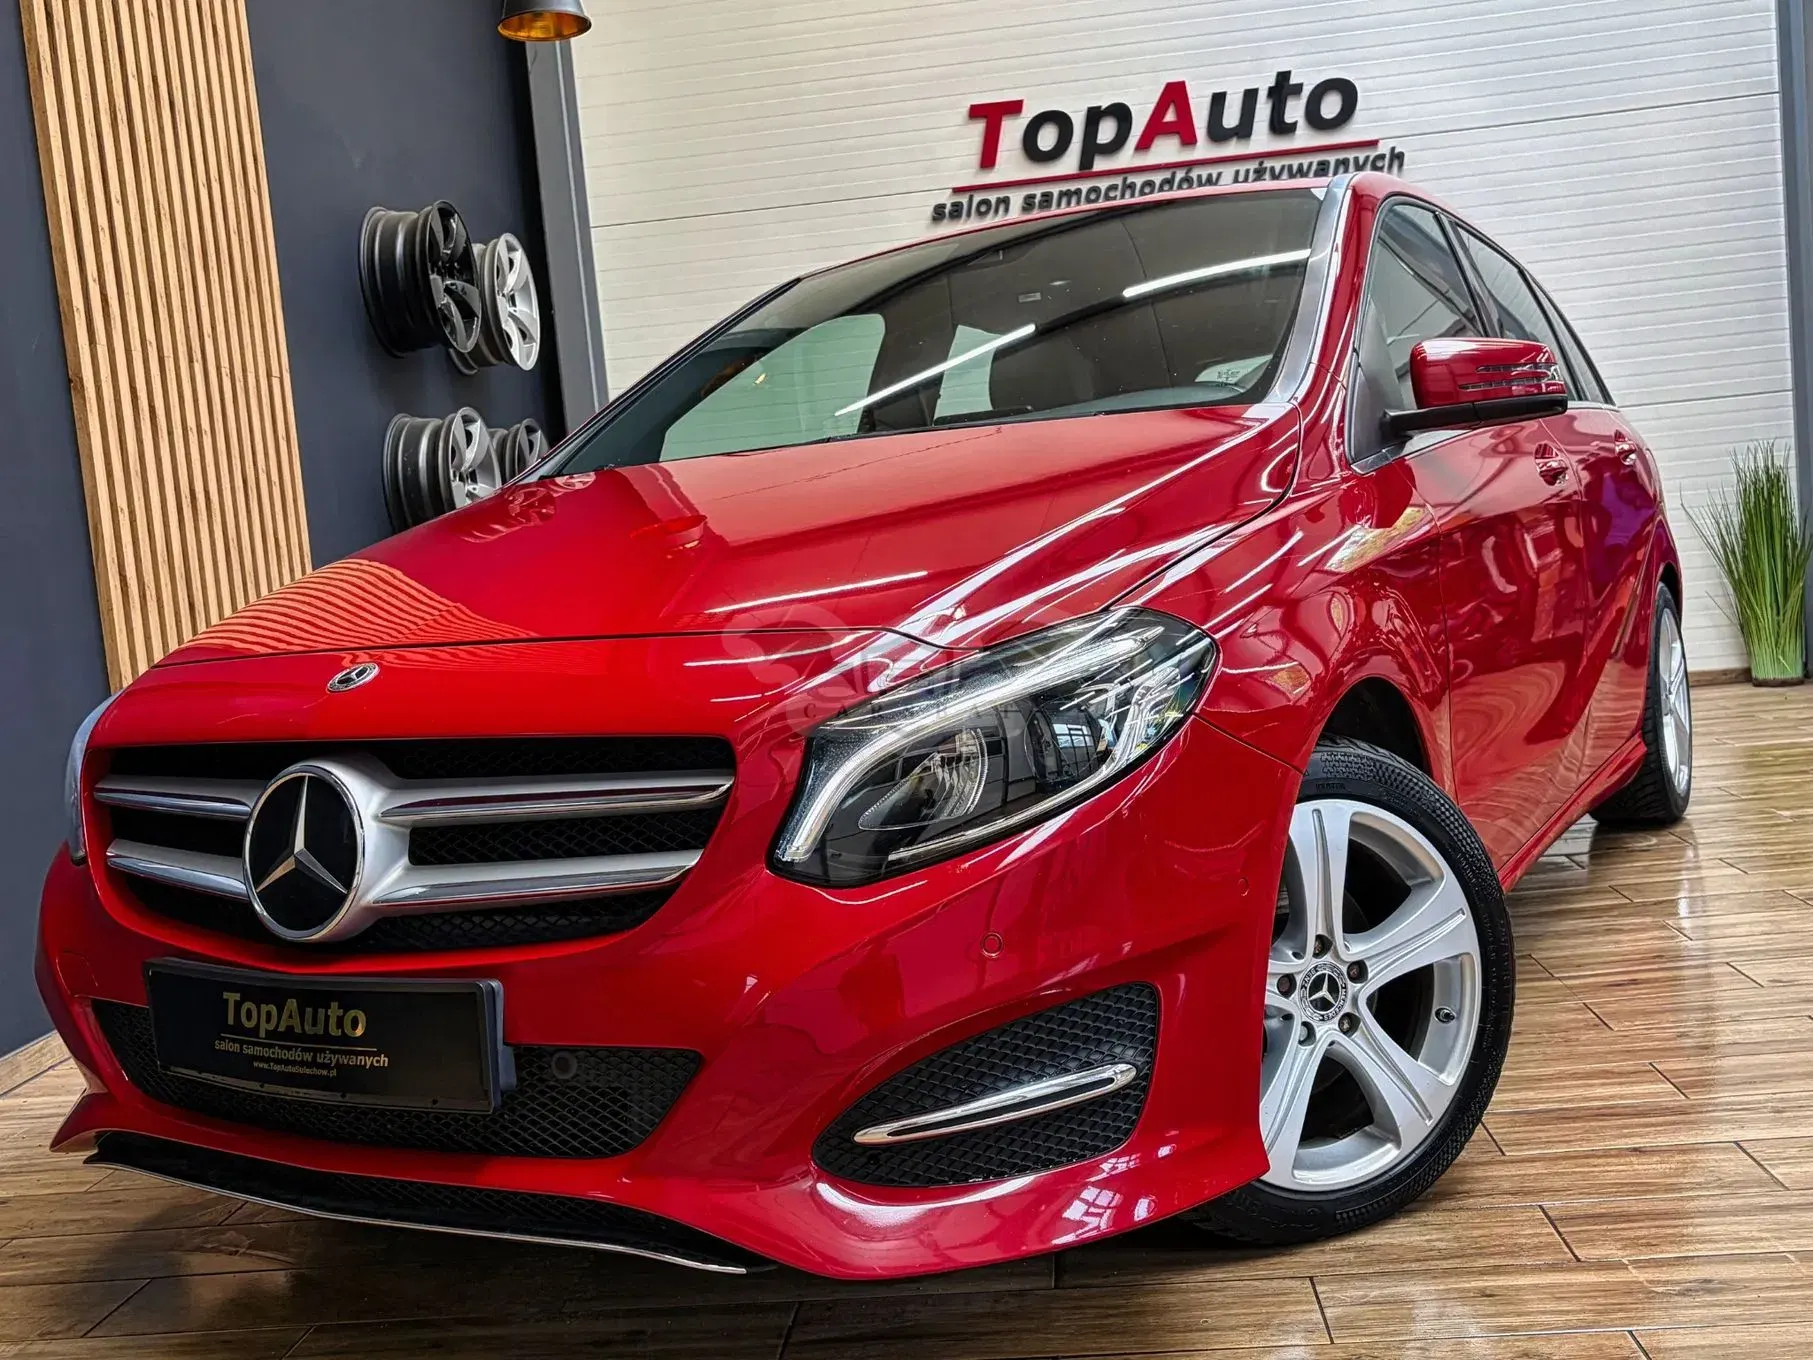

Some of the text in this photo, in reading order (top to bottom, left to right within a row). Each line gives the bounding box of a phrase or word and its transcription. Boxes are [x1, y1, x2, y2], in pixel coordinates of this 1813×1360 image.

[969, 69, 1359, 170] TopAuto
[932, 194, 1010, 222] salon
[1021, 167, 1222, 213] samochodów
[222, 991, 367, 1038] TopAuto
[214, 1038, 389, 1069] salon samochodów używanych
